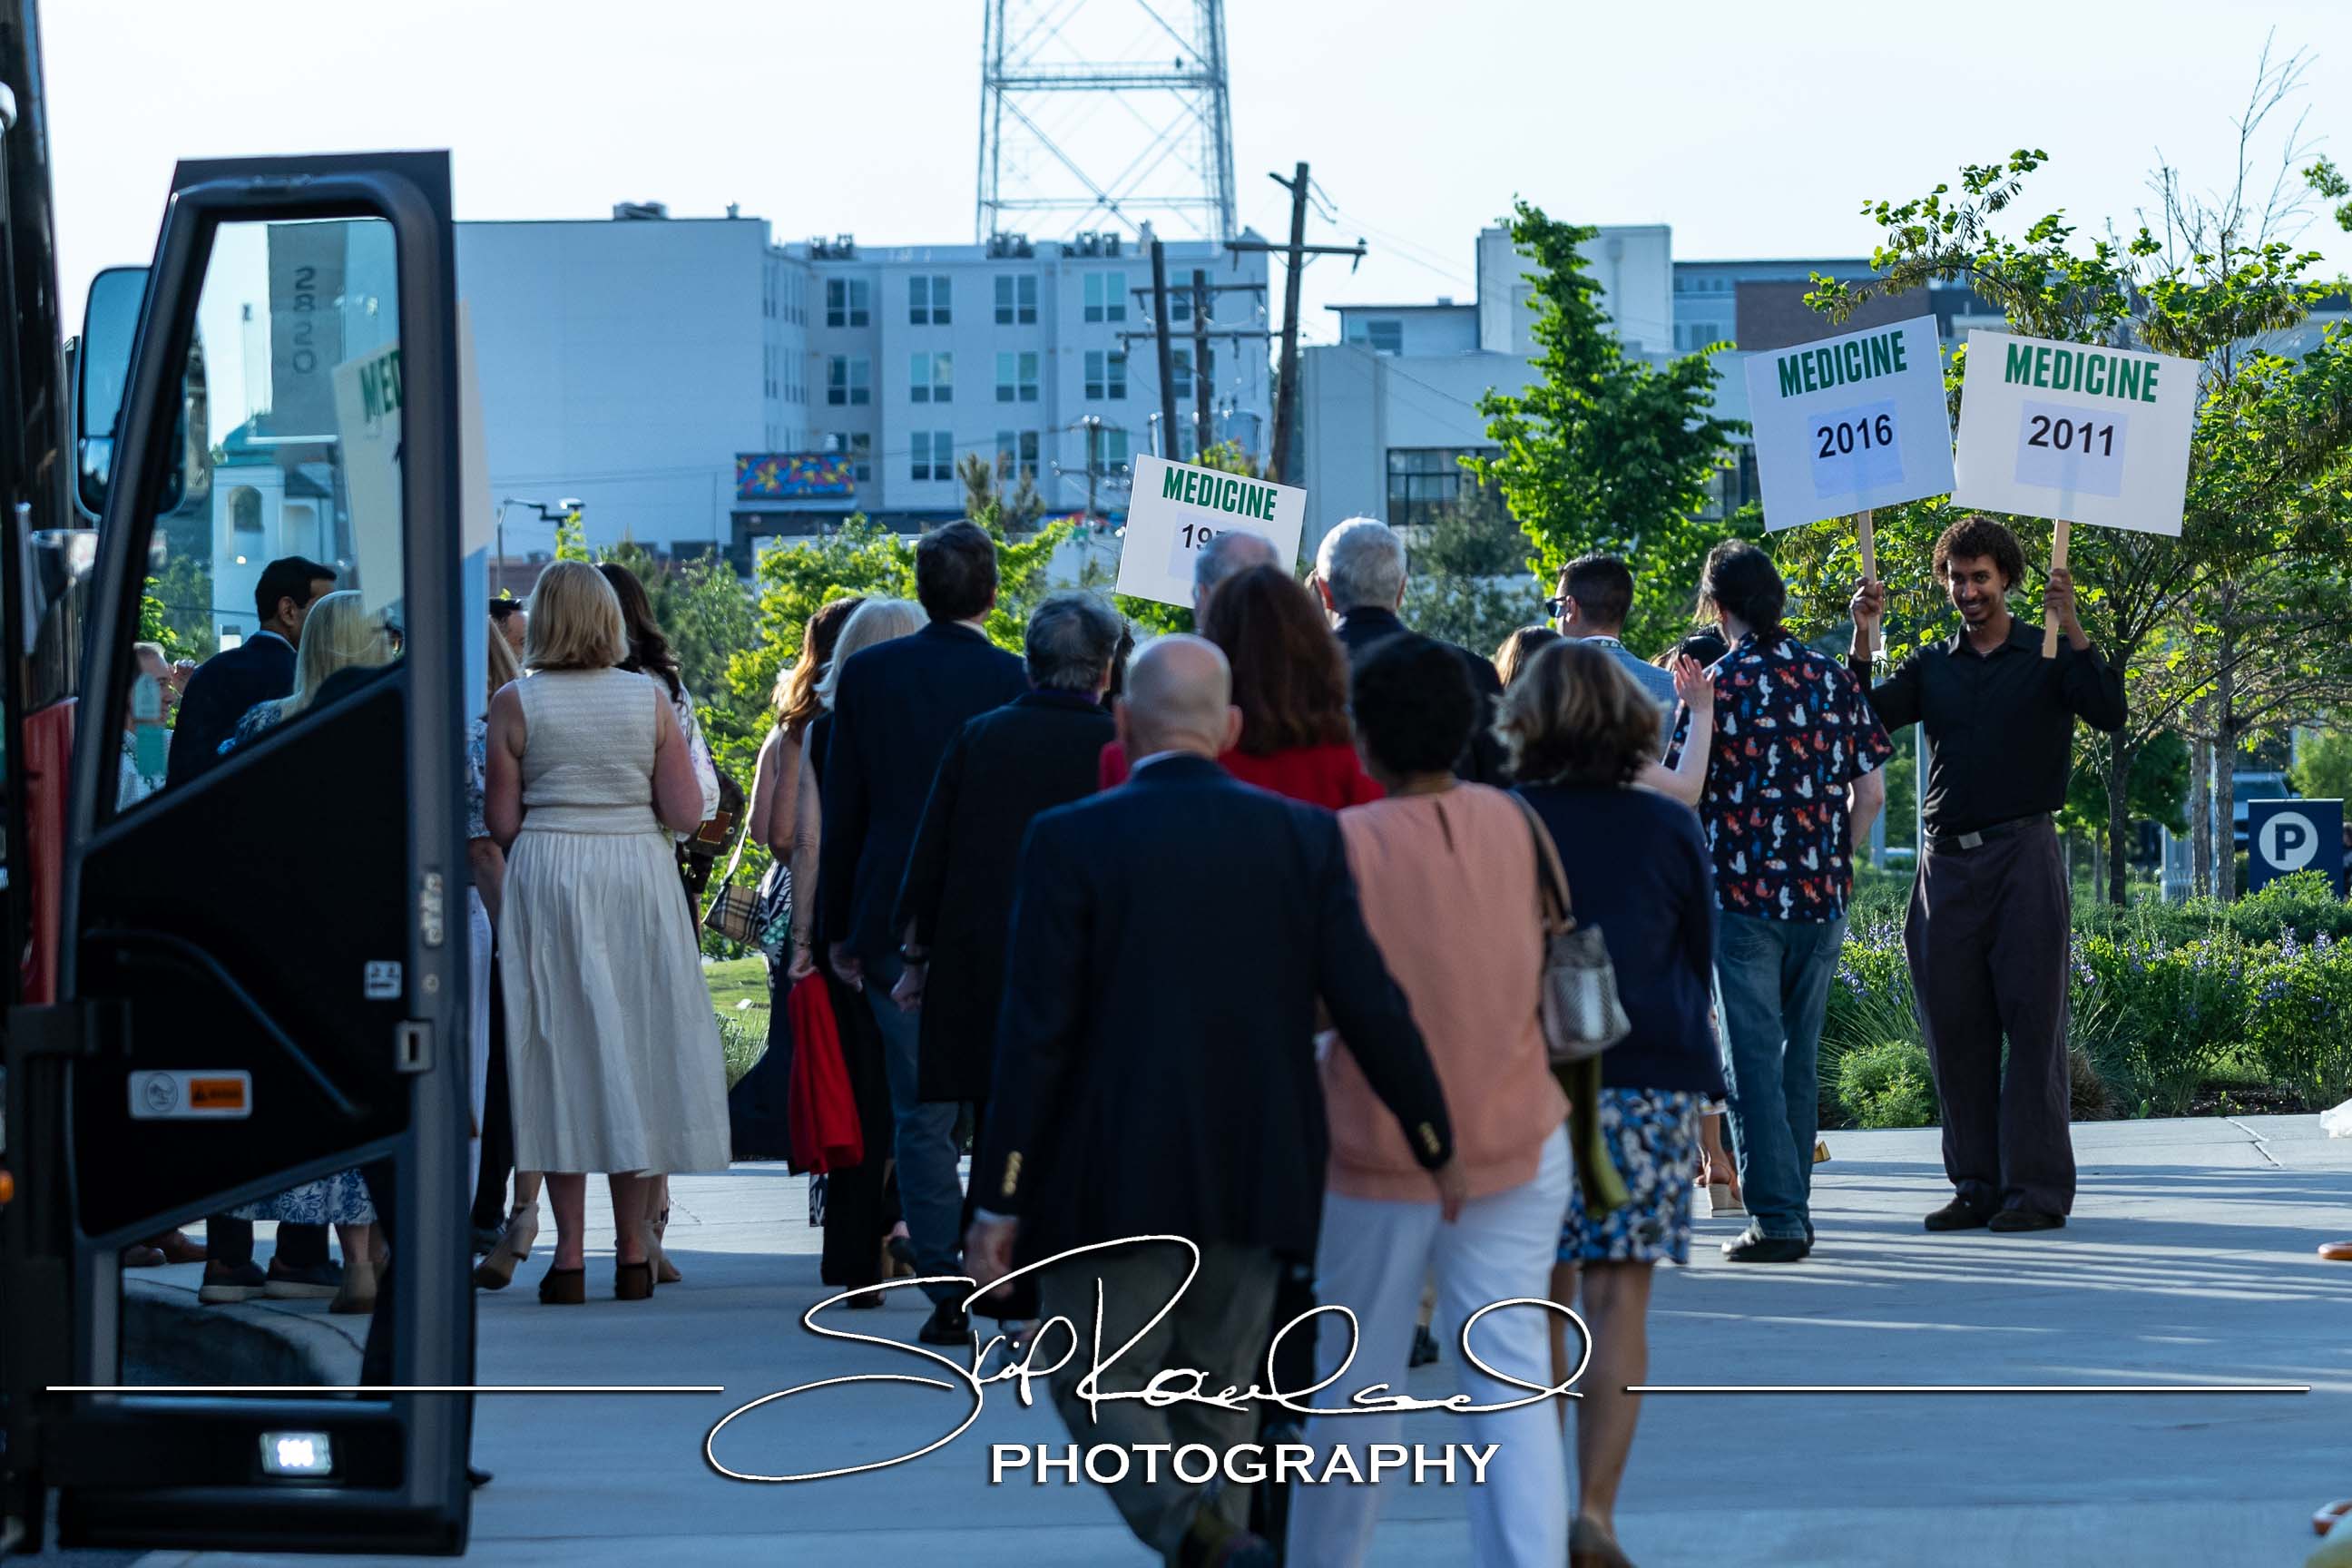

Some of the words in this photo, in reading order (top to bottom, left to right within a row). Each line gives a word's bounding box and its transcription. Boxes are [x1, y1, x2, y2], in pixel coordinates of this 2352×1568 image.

[292, 266, 317, 375] 2820
[359, 348, 402, 424] MED
[1778, 329, 1907, 398] MEDICINE
[2004, 342, 2161, 403] MEDICINE
[1817, 414, 1893, 459] 2016
[2027, 415, 2114, 457] 2011
[1162, 466, 1278, 521] MEDICINE
[1181, 524, 1226, 552] 19
[2275, 823, 2307, 861] P
